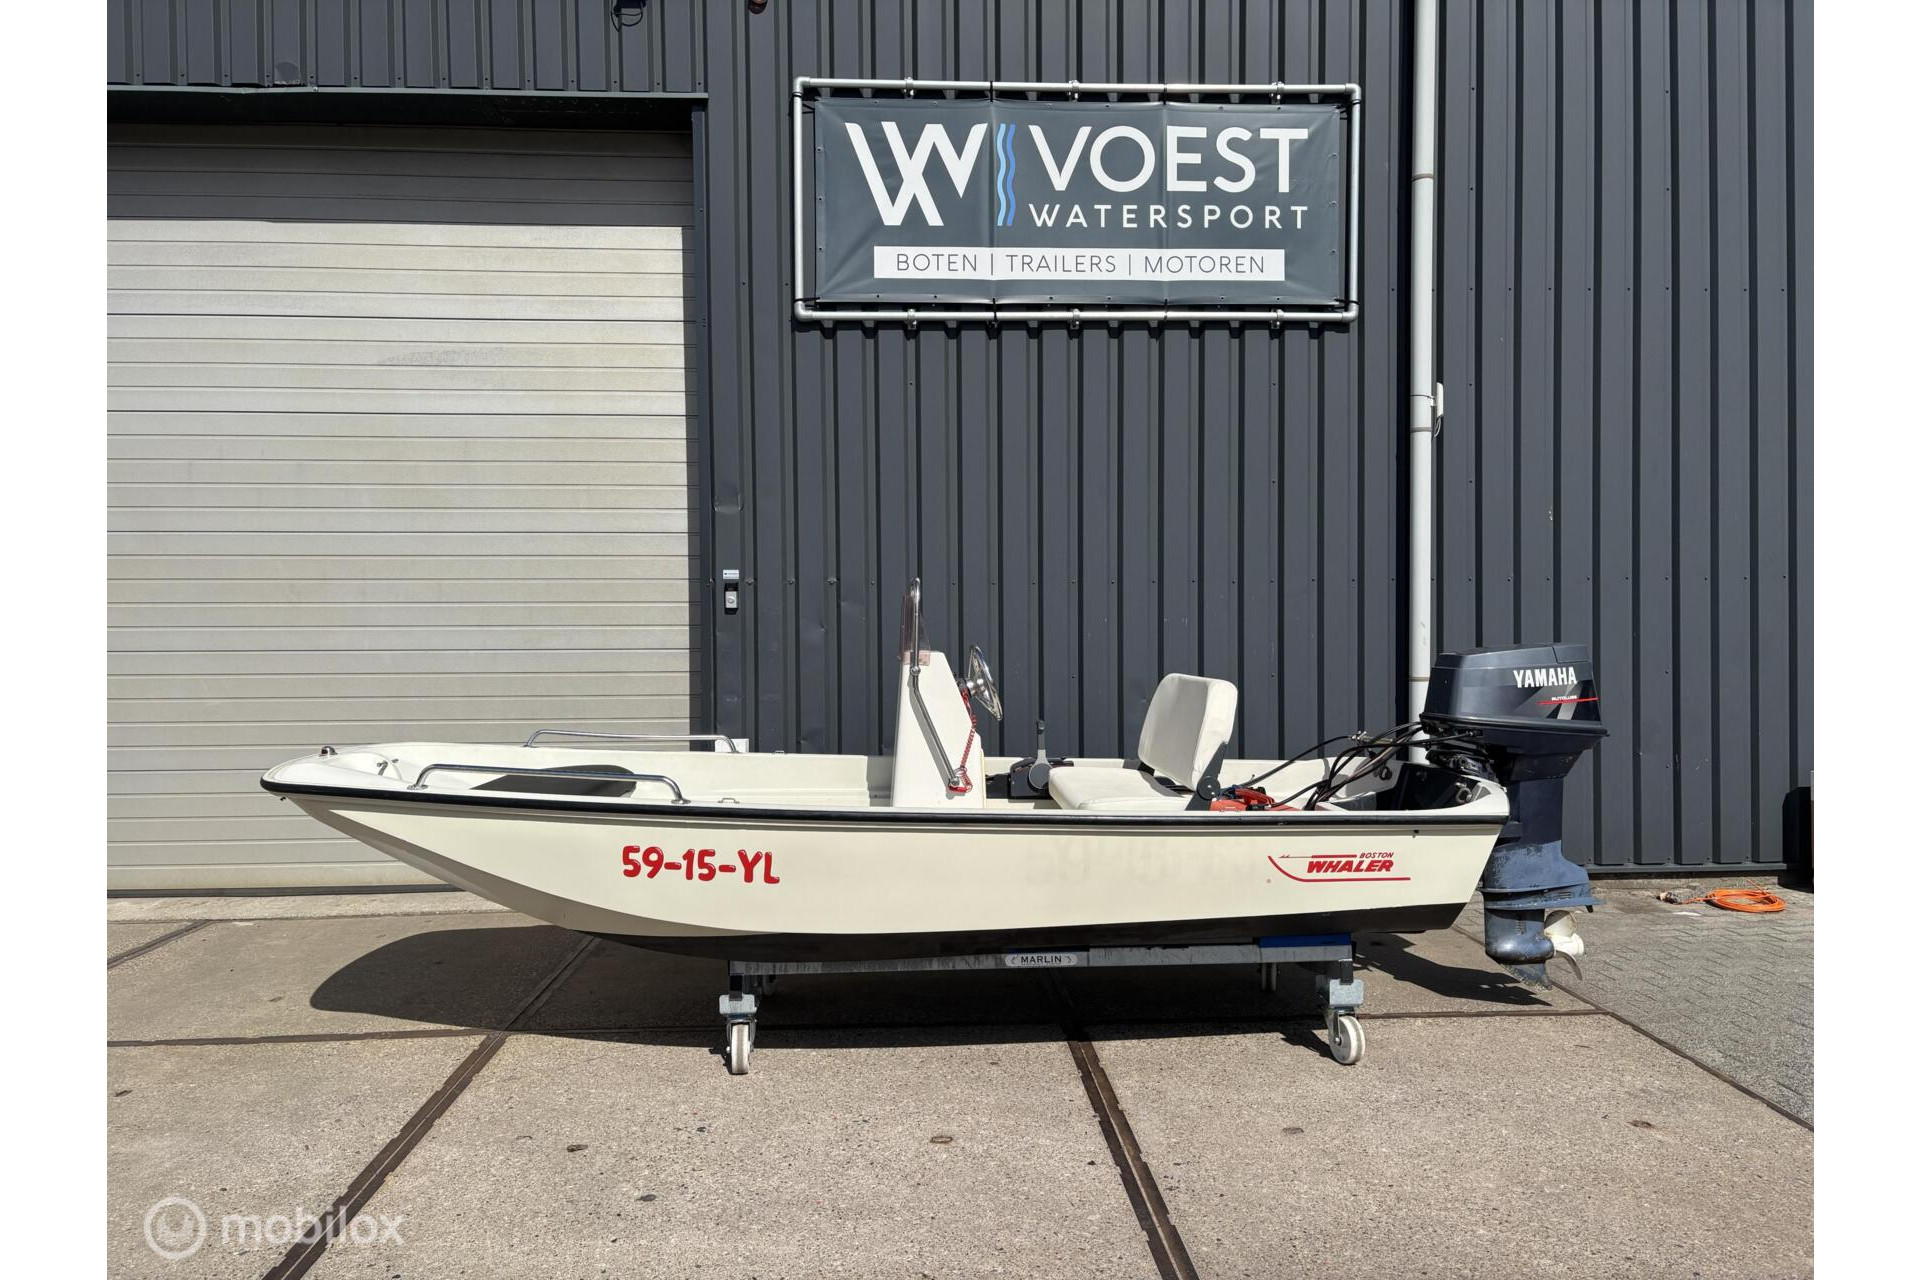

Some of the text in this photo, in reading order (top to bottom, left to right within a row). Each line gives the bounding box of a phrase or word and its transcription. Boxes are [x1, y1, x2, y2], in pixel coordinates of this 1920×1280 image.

[1027, 124, 1309, 194] VOEST
[1028, 203, 1309, 230] WATERSPORT
[896, 253, 1265, 274] BOTEN TRAILERS MOTOREN
[1512, 665, 1578, 689] YAMAHA
[622, 845, 781, 884] 59-15-YL
[1306, 859, 1394, 874] WHALER
[1020, 955, 1062, 964] MARLIN
